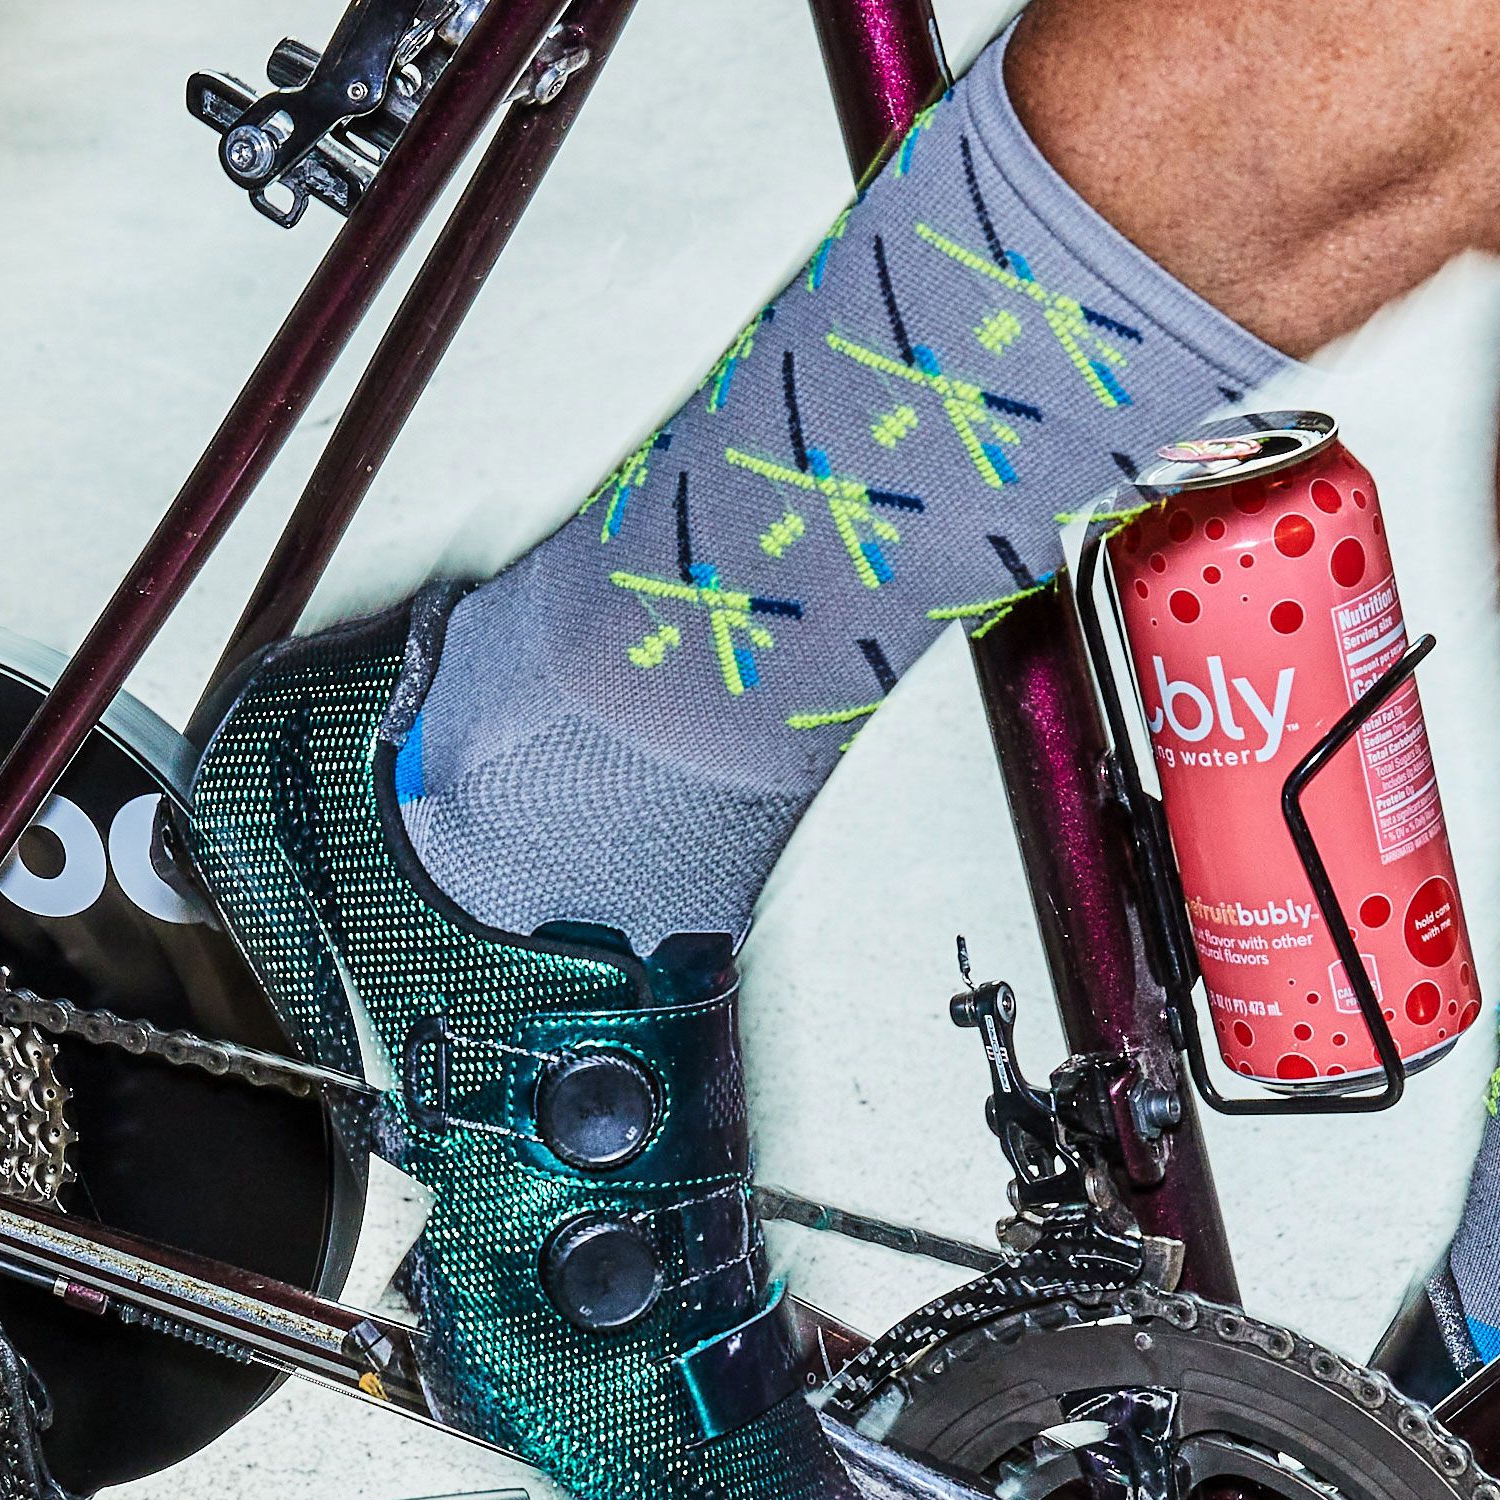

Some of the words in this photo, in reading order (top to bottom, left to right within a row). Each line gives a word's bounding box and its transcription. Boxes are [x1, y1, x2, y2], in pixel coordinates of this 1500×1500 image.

[1339, 588, 1393, 632] Nutrition
[1342, 625, 1379, 651] Serving
[1180, 748, 1251, 767] water
[1414, 911, 1435, 931] hold
[1434, 902, 1451, 919] cans
[1204, 929, 1236, 949] flavor
[1238, 937, 1269, 950] with
[1271, 934, 1314, 950] other
[1421, 926, 1441, 943] with
[1439, 918, 1452, 931] me
[1223, 949, 1270, 965] flavors
[1248, 1001, 1267, 1016] 473
